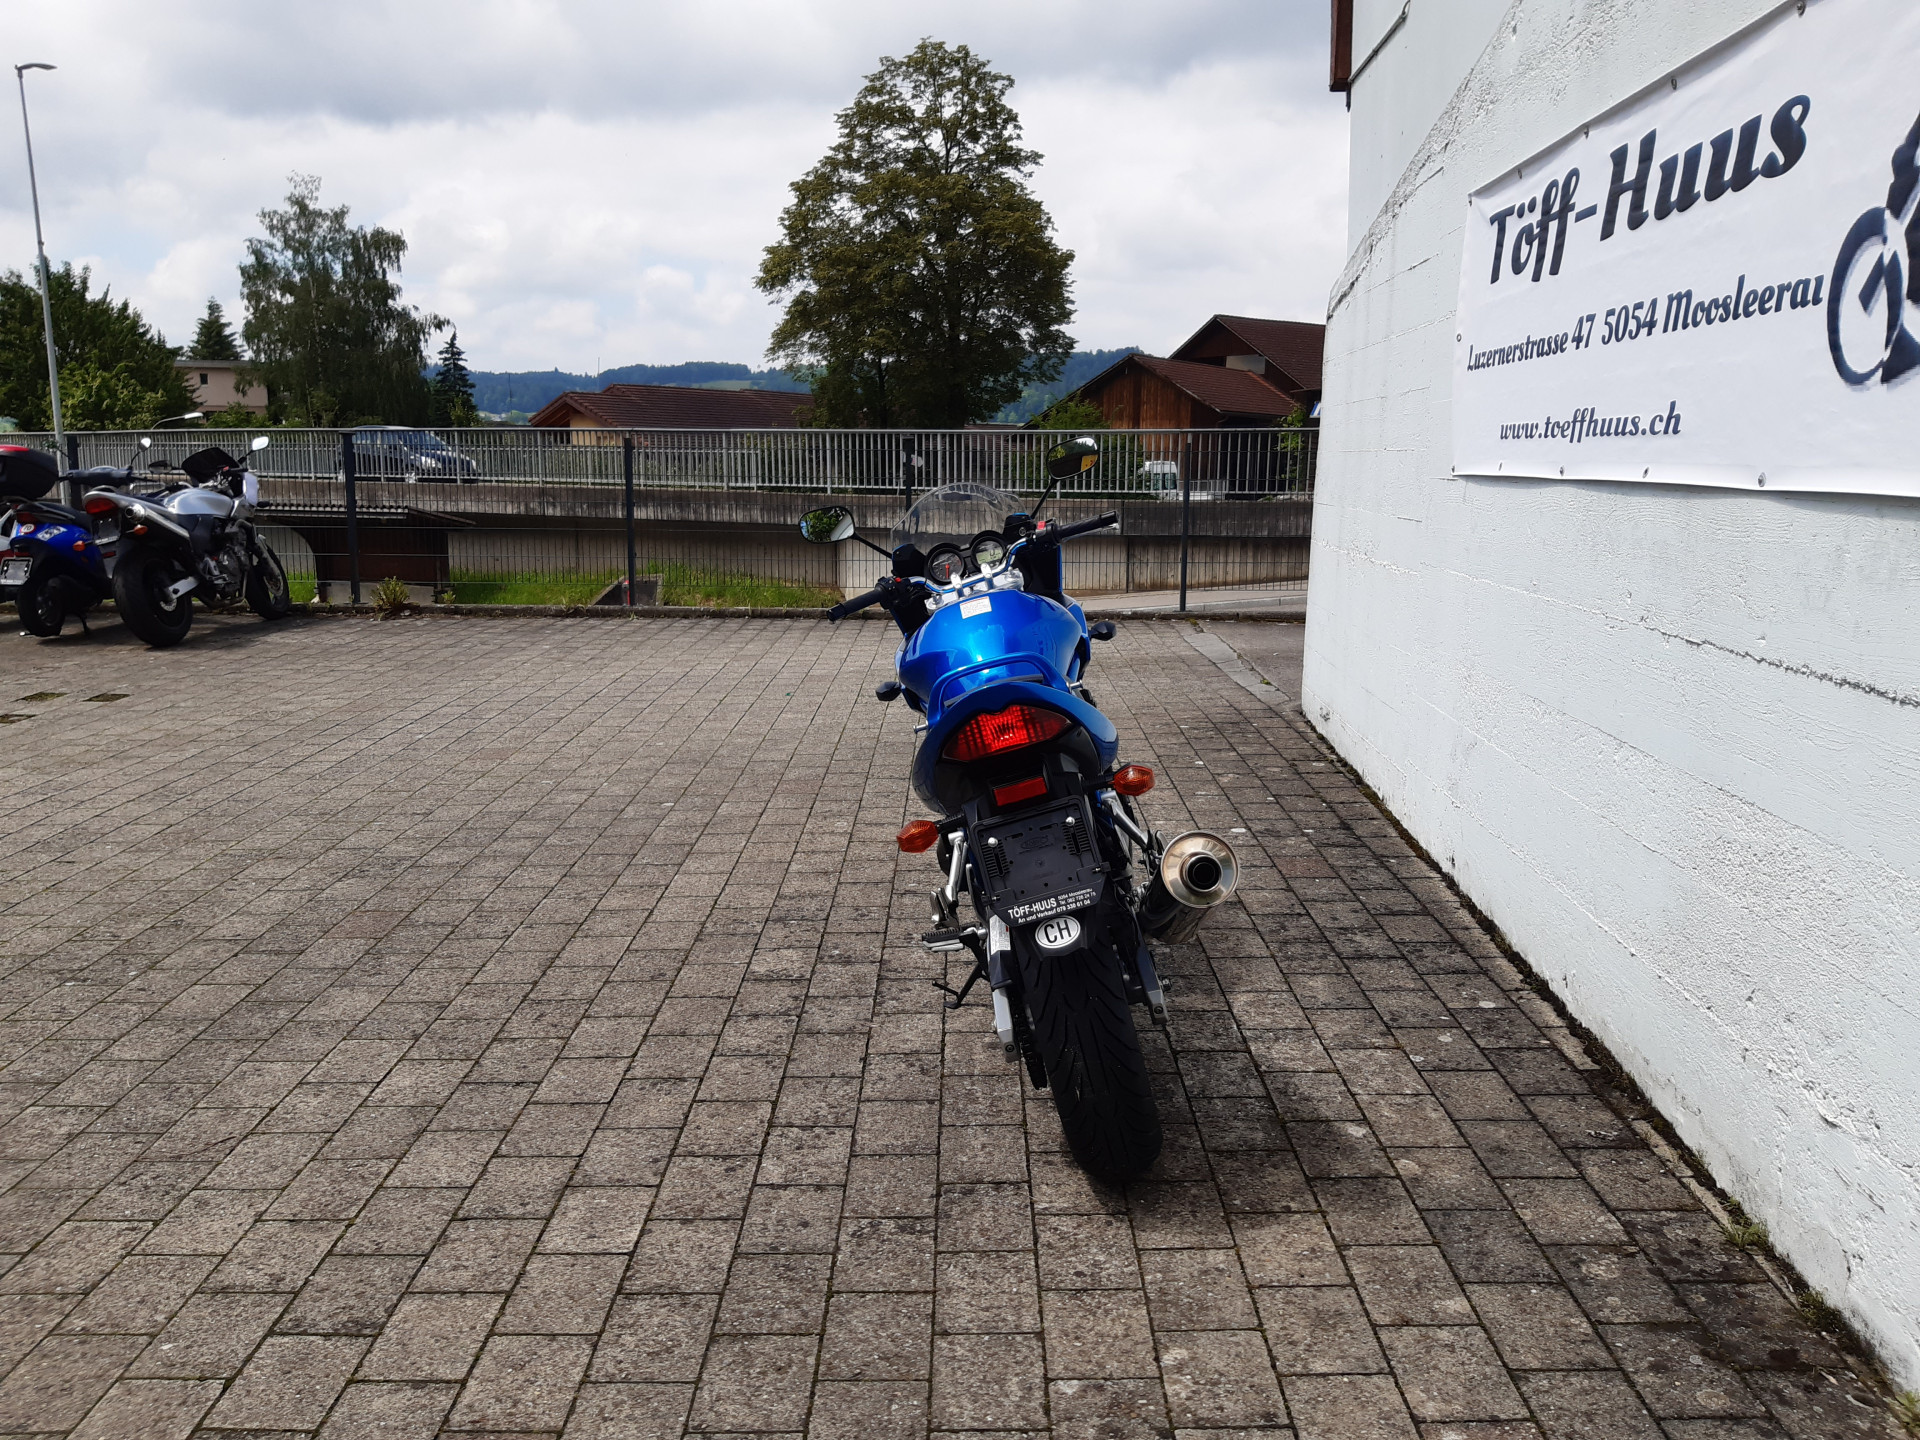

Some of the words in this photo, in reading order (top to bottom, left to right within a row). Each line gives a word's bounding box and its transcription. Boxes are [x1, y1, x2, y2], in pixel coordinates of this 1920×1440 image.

[1489, 94, 1811, 285] Töff-Huus
[1467, 331, 1569, 372] Luzernerstrasse
[1571, 313, 1597, 351] 47
[1601, 297, 1659, 346] 5054
[1500, 400, 1682, 444] www.toeffhuus.ch
[1008, 898, 1057, 919] TÖFF-HUUS
[1044, 920, 1072, 943] CH
